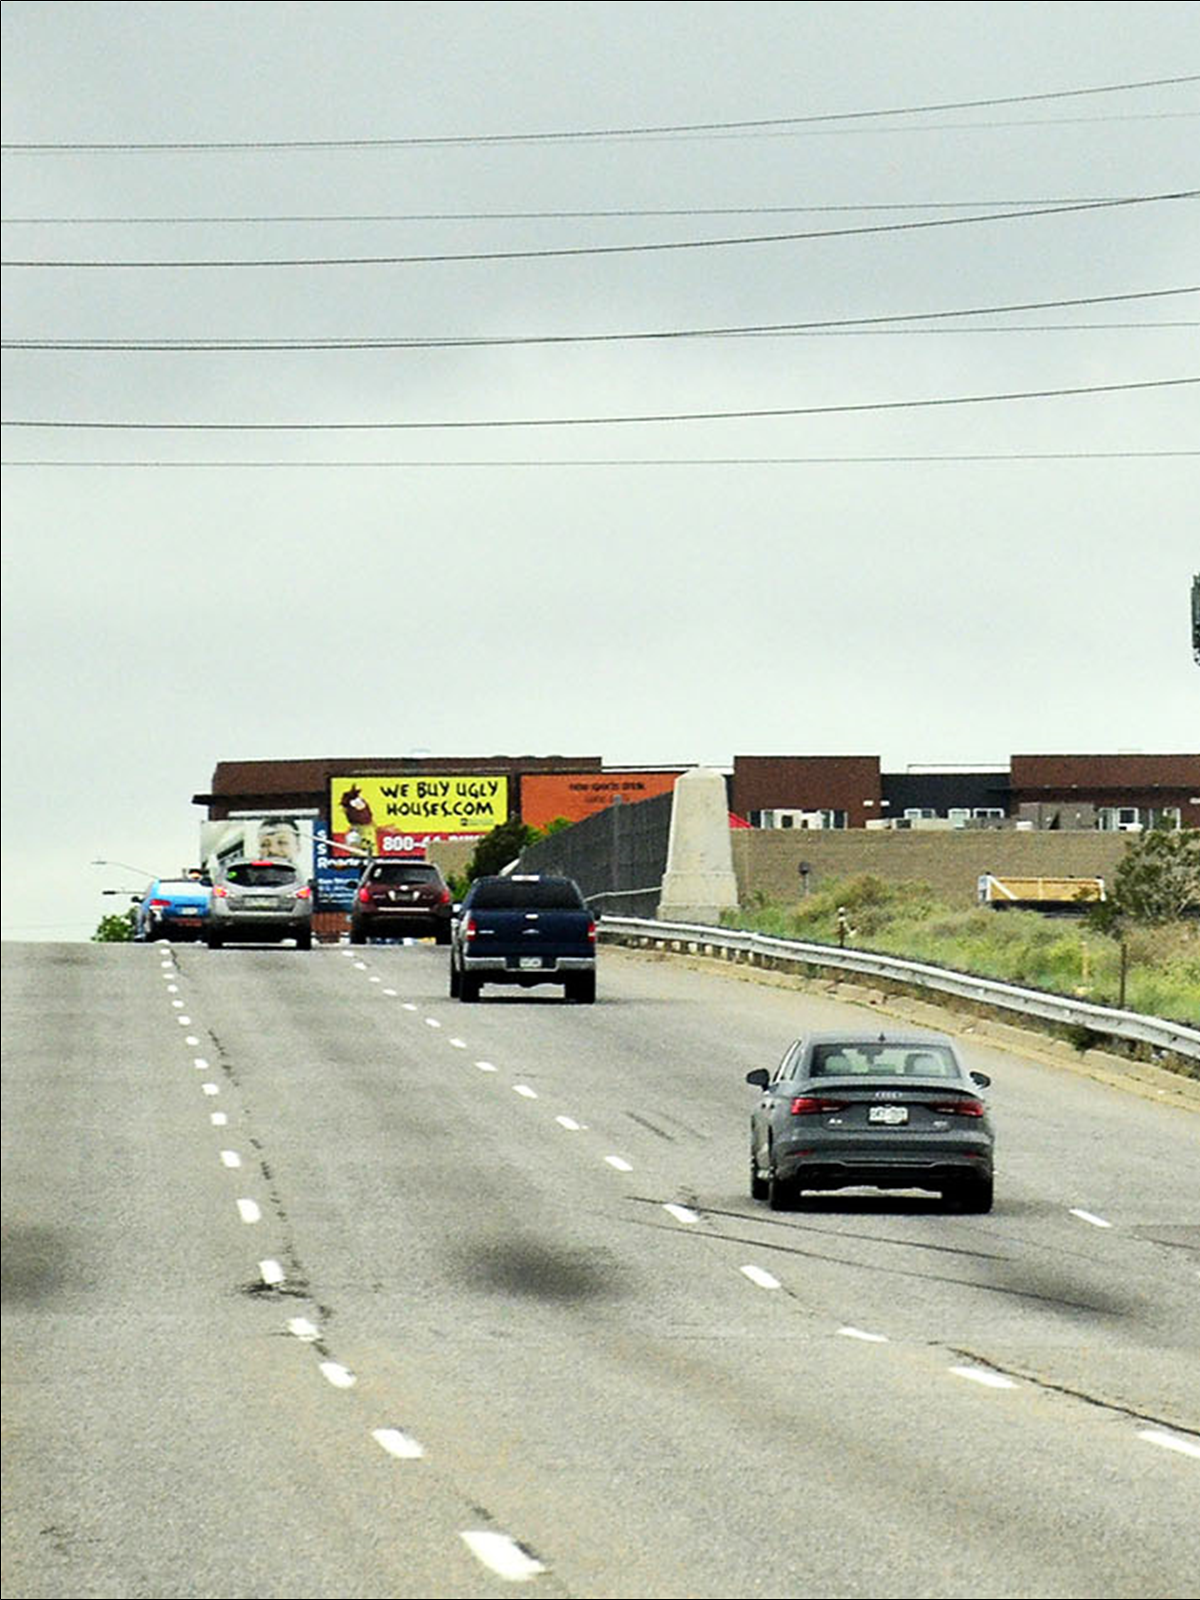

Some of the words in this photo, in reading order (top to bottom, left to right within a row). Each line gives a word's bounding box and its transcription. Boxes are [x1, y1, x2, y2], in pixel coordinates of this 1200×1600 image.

[380, 783, 410, 799] WE
[416, 781, 450, 799] BUY
[456, 781, 498, 798] UGLY
[386, 801, 494, 818] HOUSES.COM
